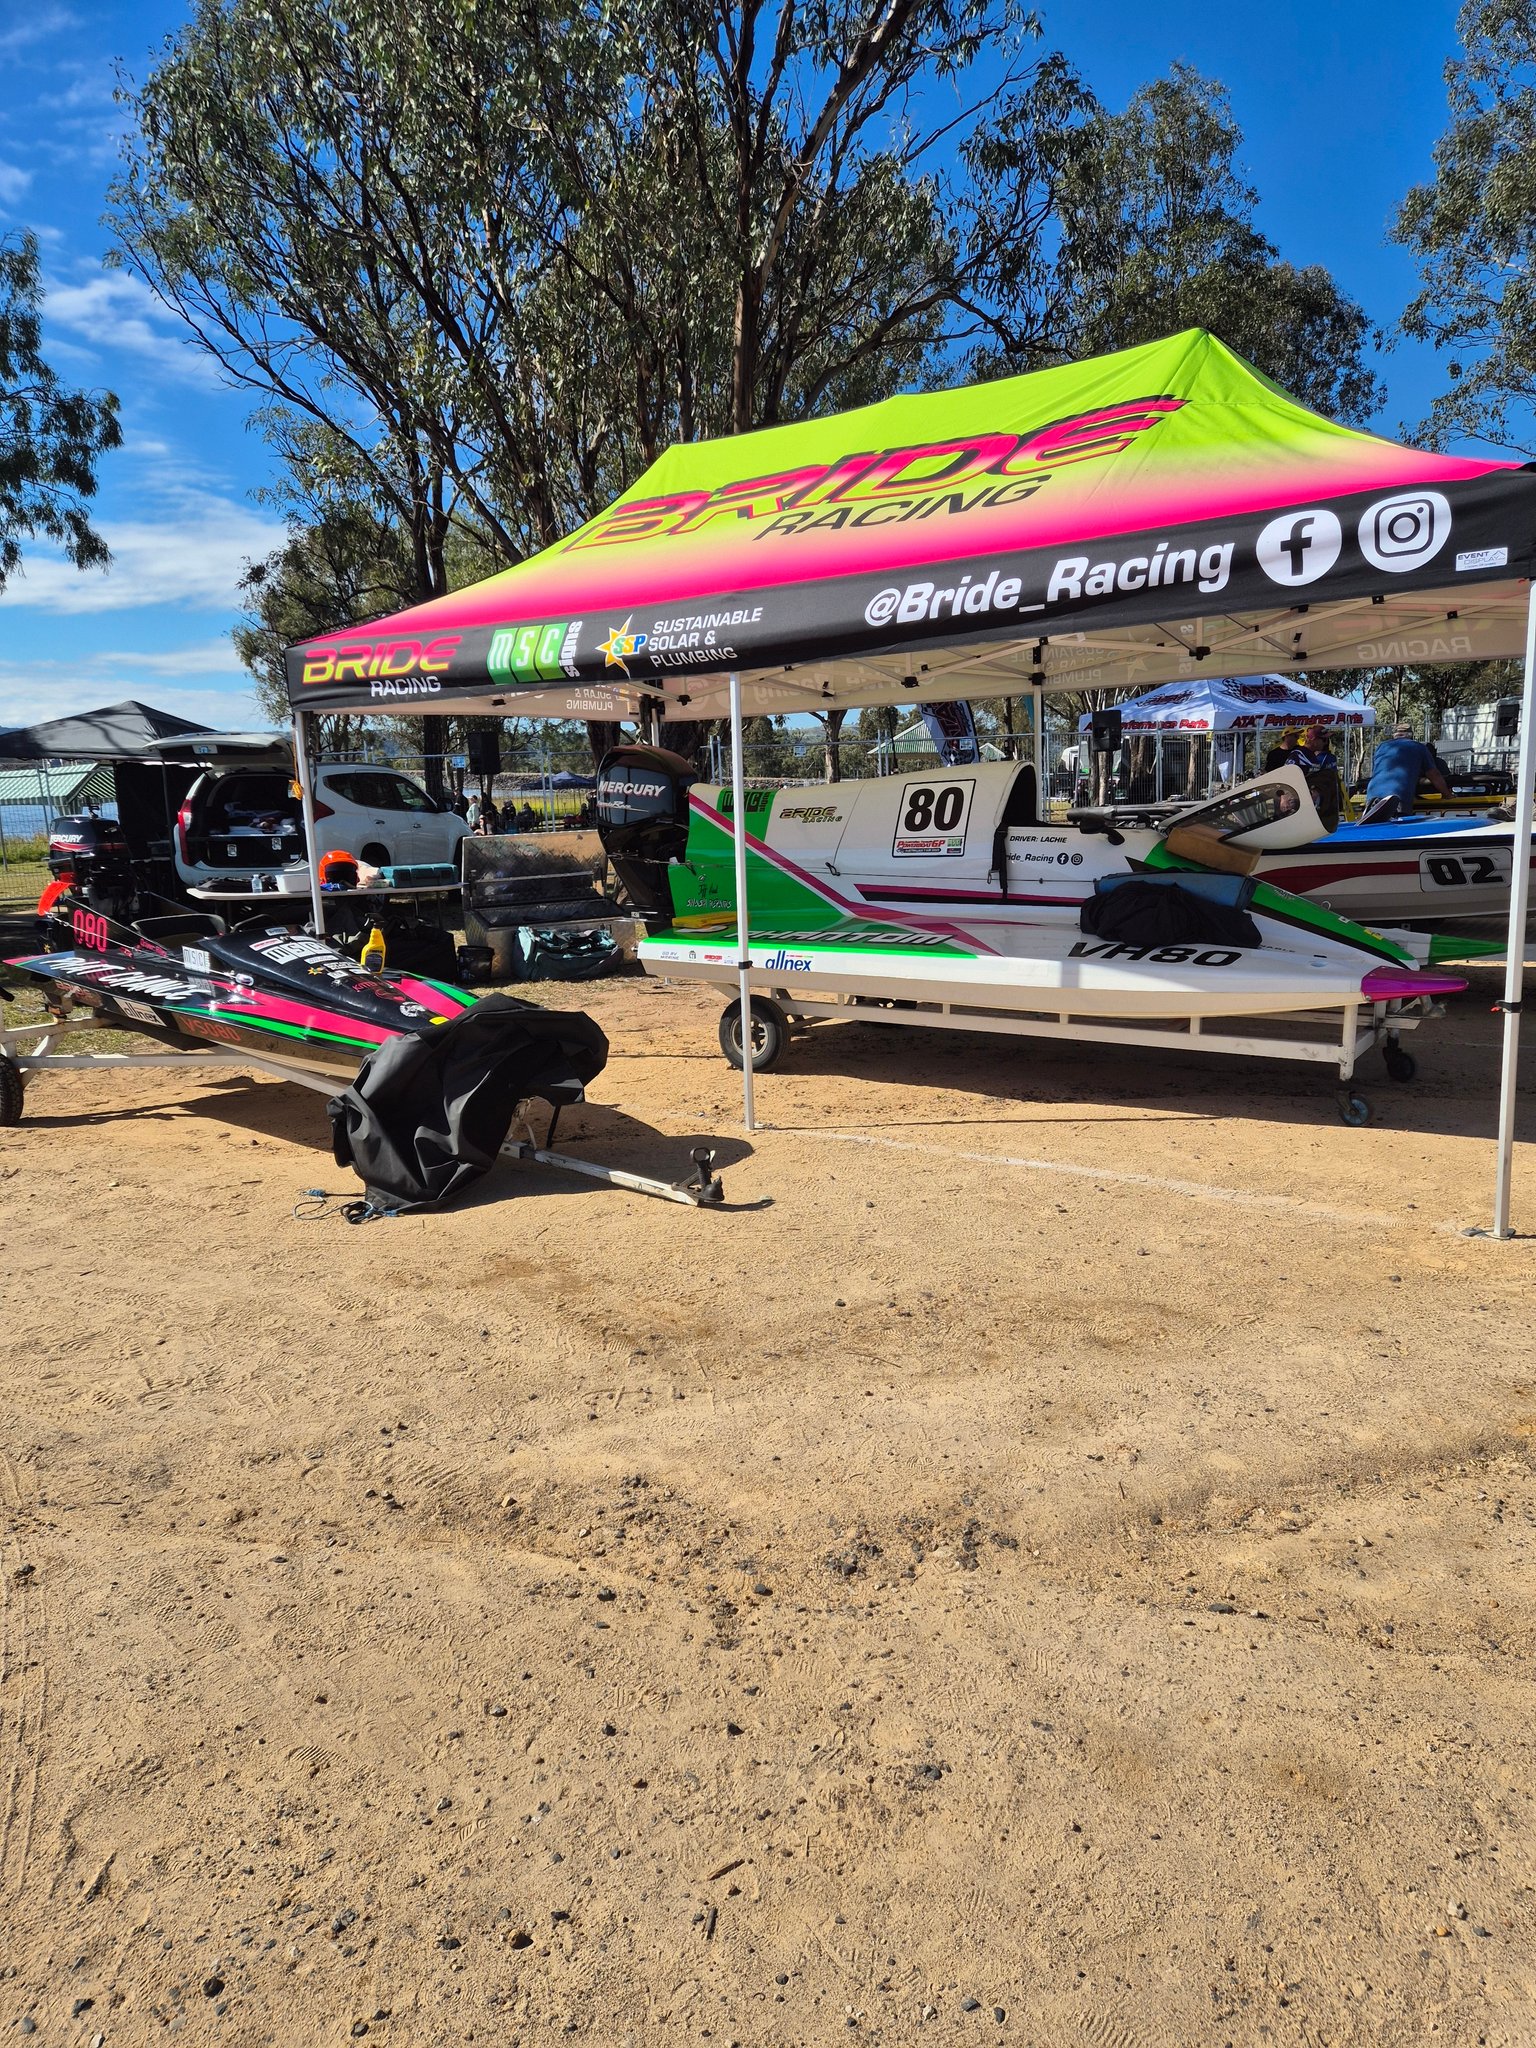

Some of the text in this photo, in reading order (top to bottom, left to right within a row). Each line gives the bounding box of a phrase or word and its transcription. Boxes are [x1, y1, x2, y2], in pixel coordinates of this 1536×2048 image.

[561, 394, 1190, 553] BRIDE
[753, 474, 1053, 541] RACING
[1458, 551, 1489, 560] EVENT
[864, 542, 1235, 627] @Bride_Racing
[652, 607, 763, 635] SUSTAINABLE
[610, 634, 648, 657] SSP
[648, 630, 717, 651] SOLAR &
[302, 636, 462, 684] BRIDE
[650, 646, 738, 668] PLUMBING
[370, 676, 441, 697] RACING
[1178, 719, 1209, 729] Parts
[1264, 713, 1335, 726] Performance
[599, 780, 666, 797] MERCURY
[780, 806, 838, 819] BRIDE
[802, 815, 842, 823] RACING
[904, 787, 964, 832] 80
[1427, 857, 1504, 885] 02
[73, 909, 107, 953] 080
[765, 950, 811, 971] allnex
[1067, 942, 1242, 967] VH80
[124, 1001, 160, 1022] allnex
